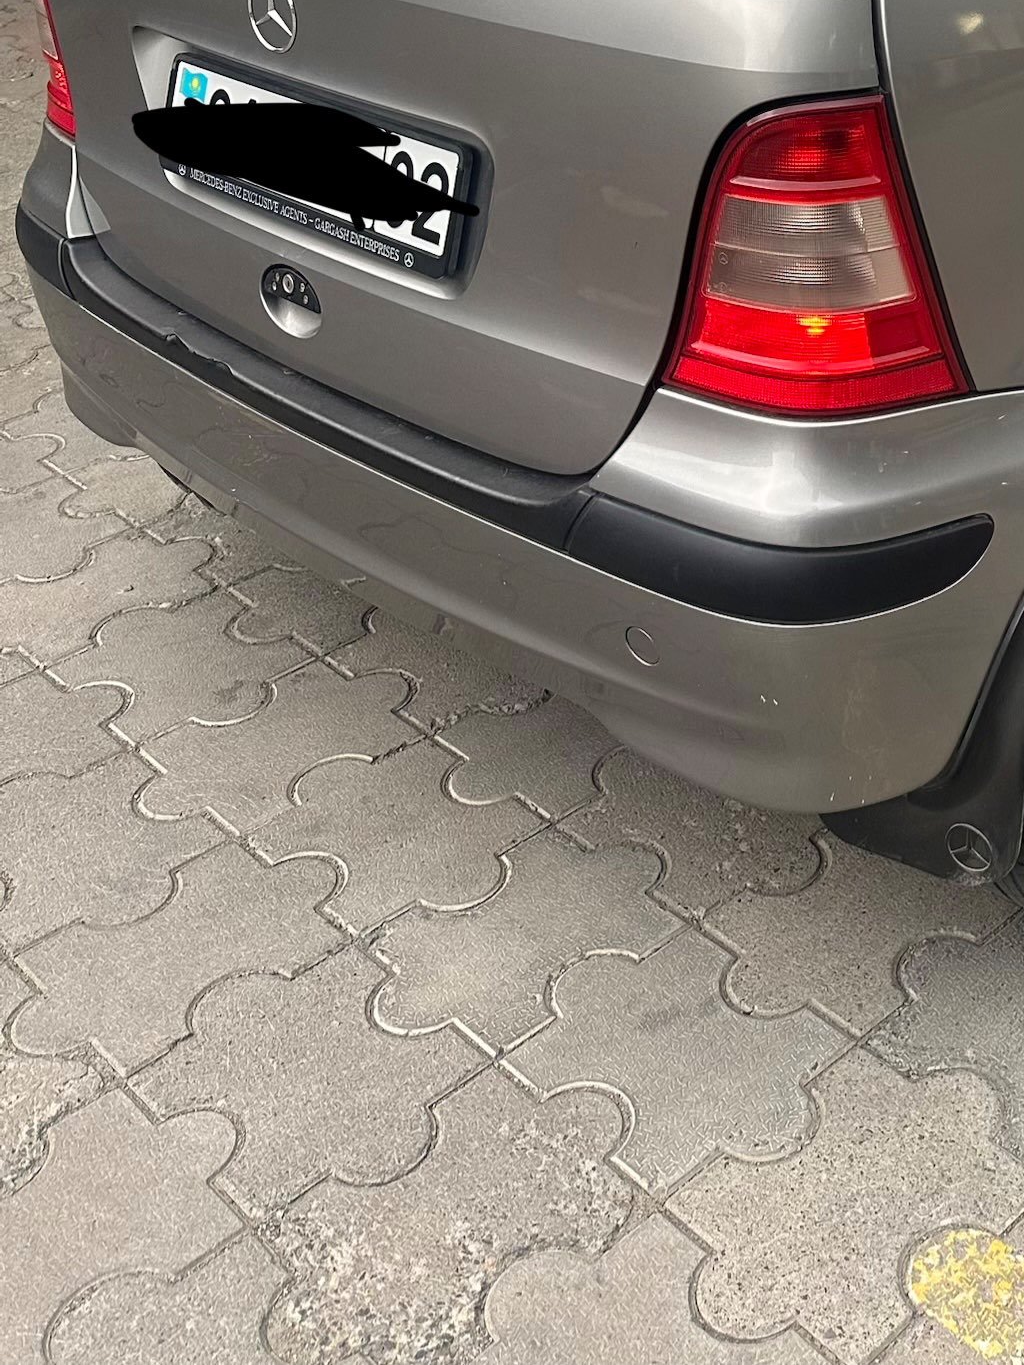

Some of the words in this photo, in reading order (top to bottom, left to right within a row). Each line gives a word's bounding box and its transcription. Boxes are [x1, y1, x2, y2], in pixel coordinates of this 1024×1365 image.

[190, 167, 242, 199] MERCEDES-BENZ
[242, 187, 279, 213] EXCLUSIVE
[280, 205, 308, 225] AGENTS
[314, 217, 349, 242] GARGASH
[350, 231, 400, 262] ENTERPRISES
